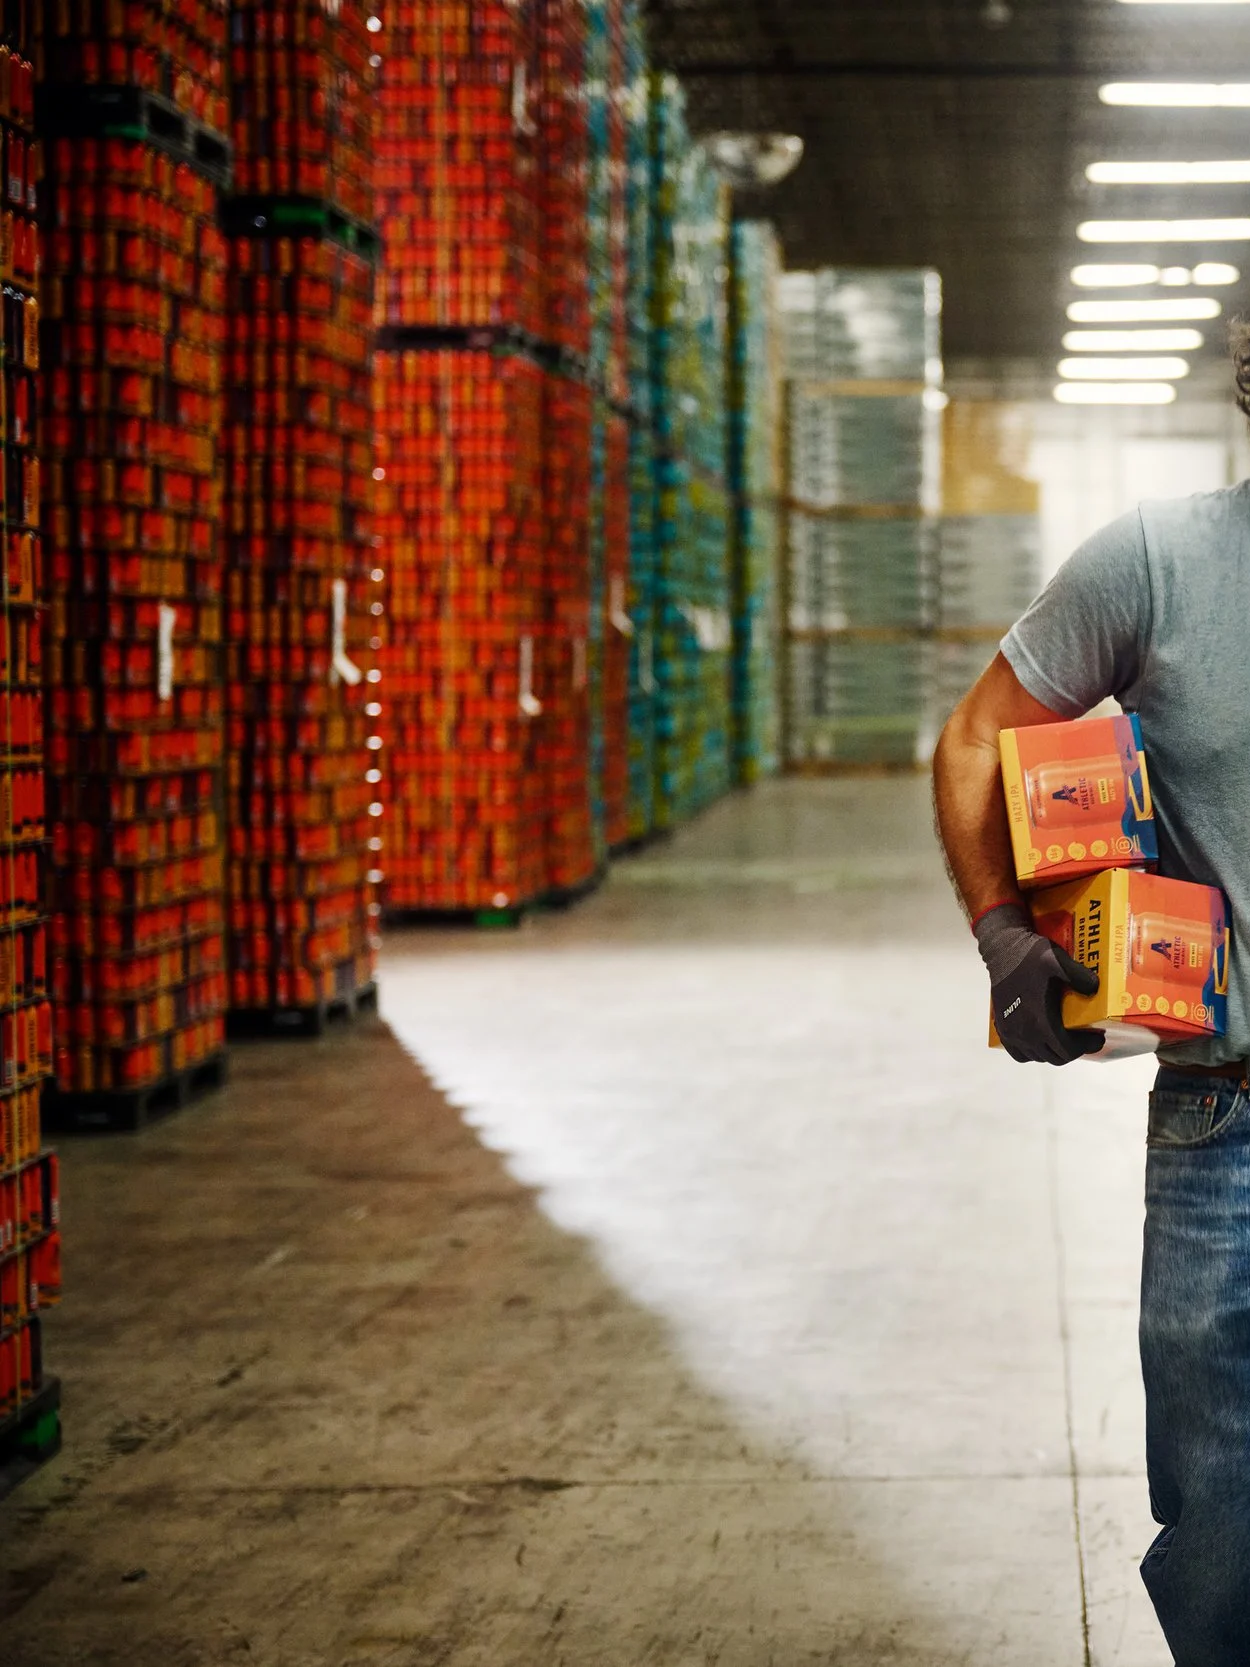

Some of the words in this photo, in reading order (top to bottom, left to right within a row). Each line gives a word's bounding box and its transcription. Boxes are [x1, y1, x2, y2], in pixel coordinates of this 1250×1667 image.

[1010, 783, 1020, 799] IPA
[1052, 784, 1079, 806] A
[1079, 778, 1090, 811] ATHLETIC
[1013, 800, 1024, 823] HAZY
[1078, 917, 1086, 965] BREWIN
[1087, 899, 1102, 974] ATHLET
[1115, 924, 1124, 939] IPA
[1115, 941, 1124, 964] HAZY
[1174, 936, 1182, 969] ATHLETIC
[1003, 996, 1021, 1019] ULINE
